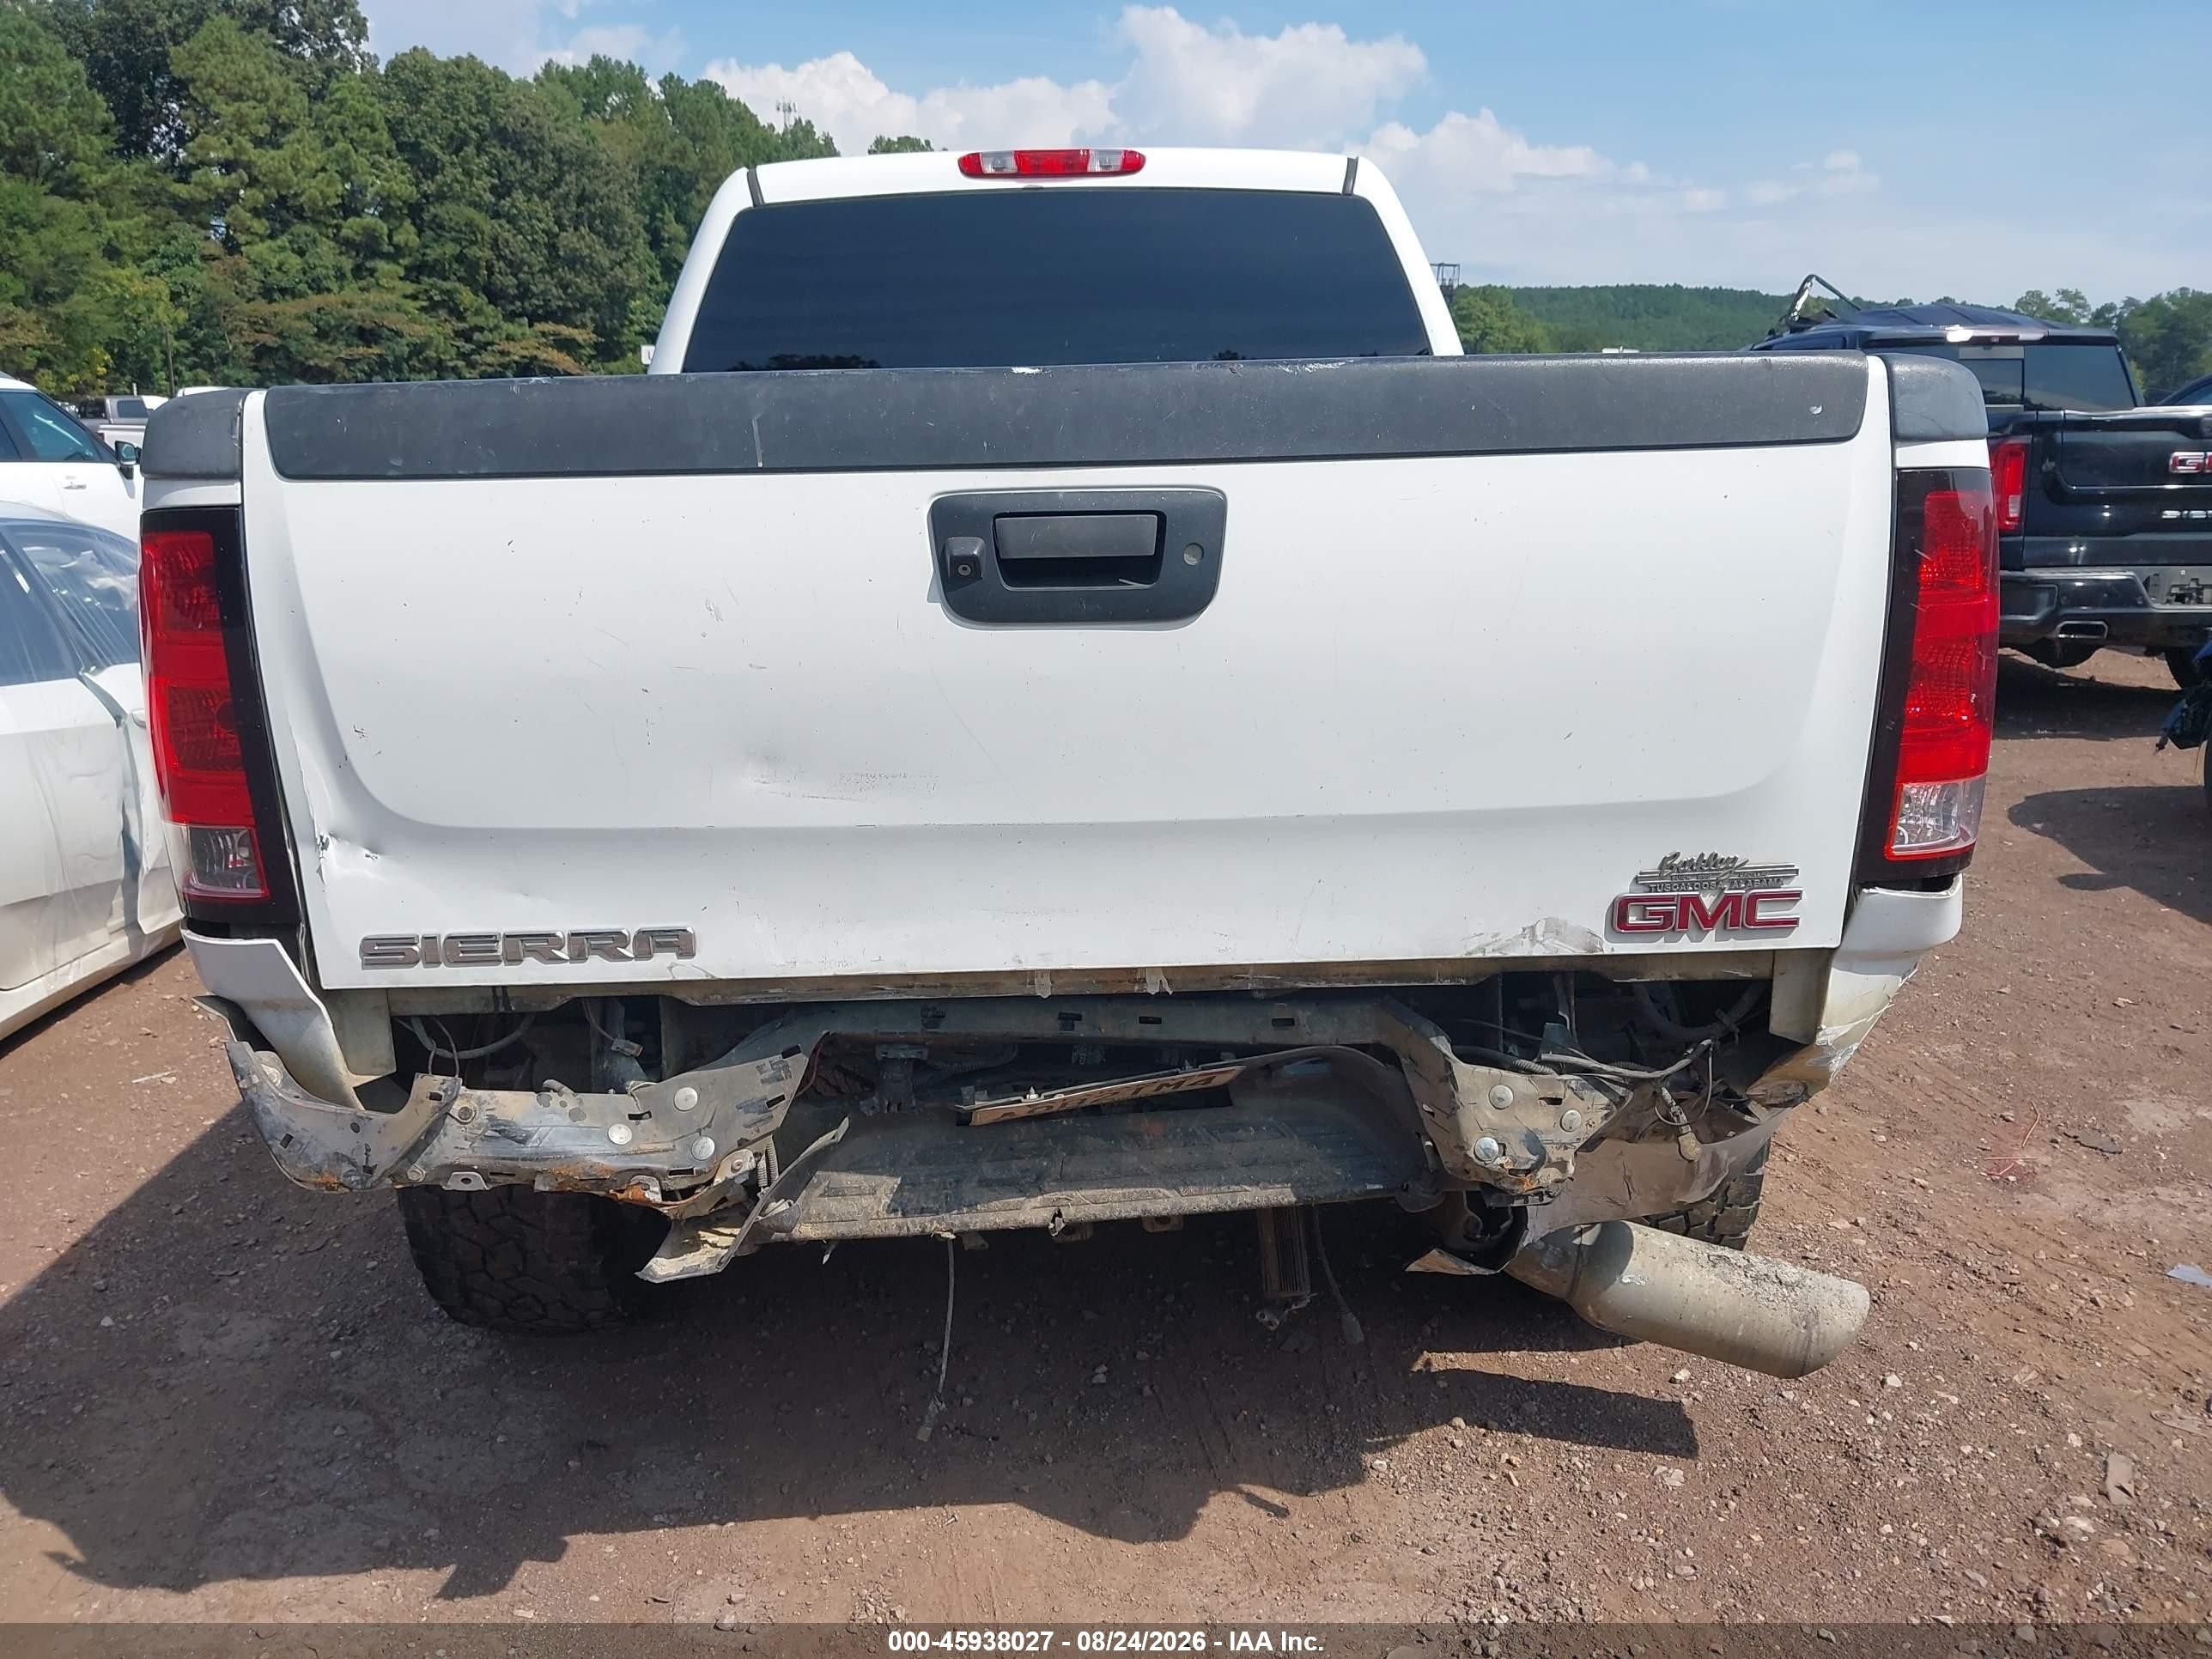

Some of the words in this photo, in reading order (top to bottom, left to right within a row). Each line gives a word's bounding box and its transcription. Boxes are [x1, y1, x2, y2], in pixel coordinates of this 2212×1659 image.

[2169, 452, 2212, 473] G
[1732, 878, 1784, 889] ALABAMA
[1613, 888, 1803, 933] GMC
[362, 927, 697, 969] SIERRA
